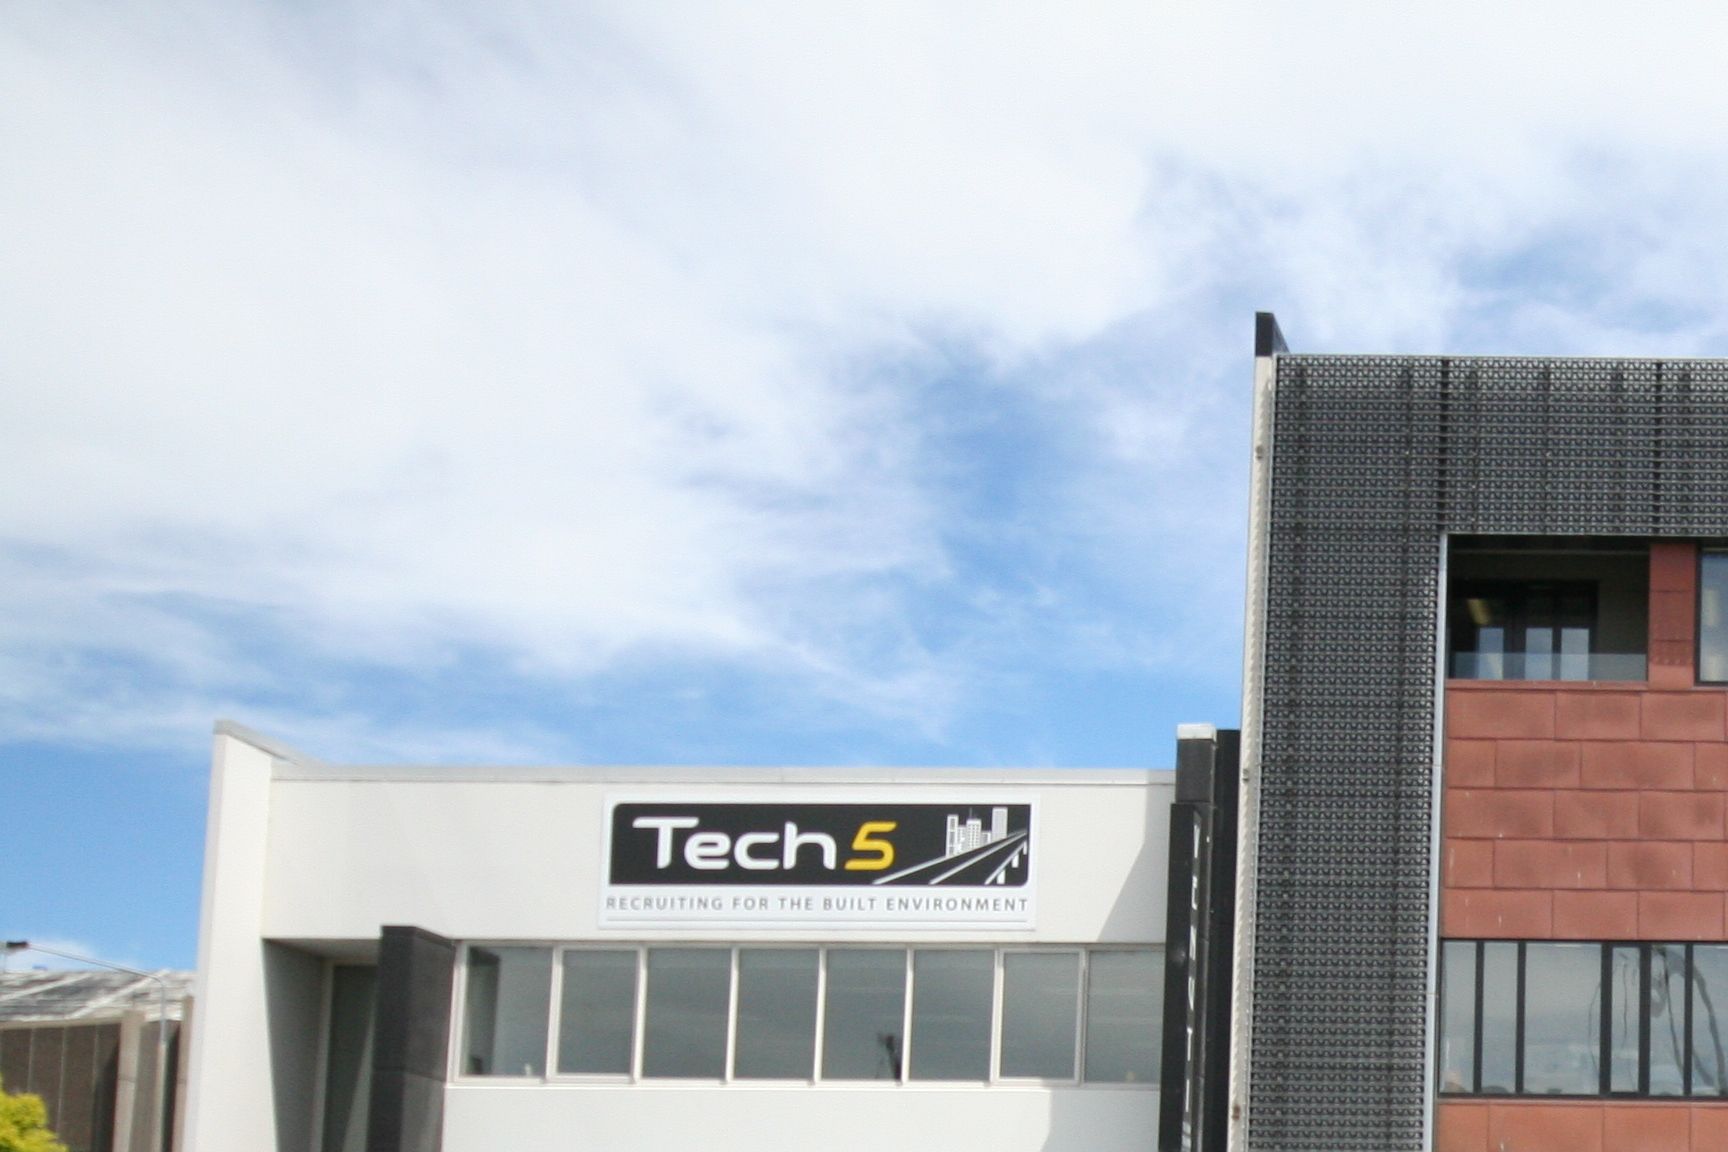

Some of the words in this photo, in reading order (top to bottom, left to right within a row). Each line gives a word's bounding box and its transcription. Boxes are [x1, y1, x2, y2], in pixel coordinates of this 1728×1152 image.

[606, 898, 723, 911] RECRUITING
[732, 898, 769, 911] FOR
[778, 898, 814, 911] THE
[823, 898, 876, 911] BUILT
[886, 898, 1028, 912] ENVIRONMENT
